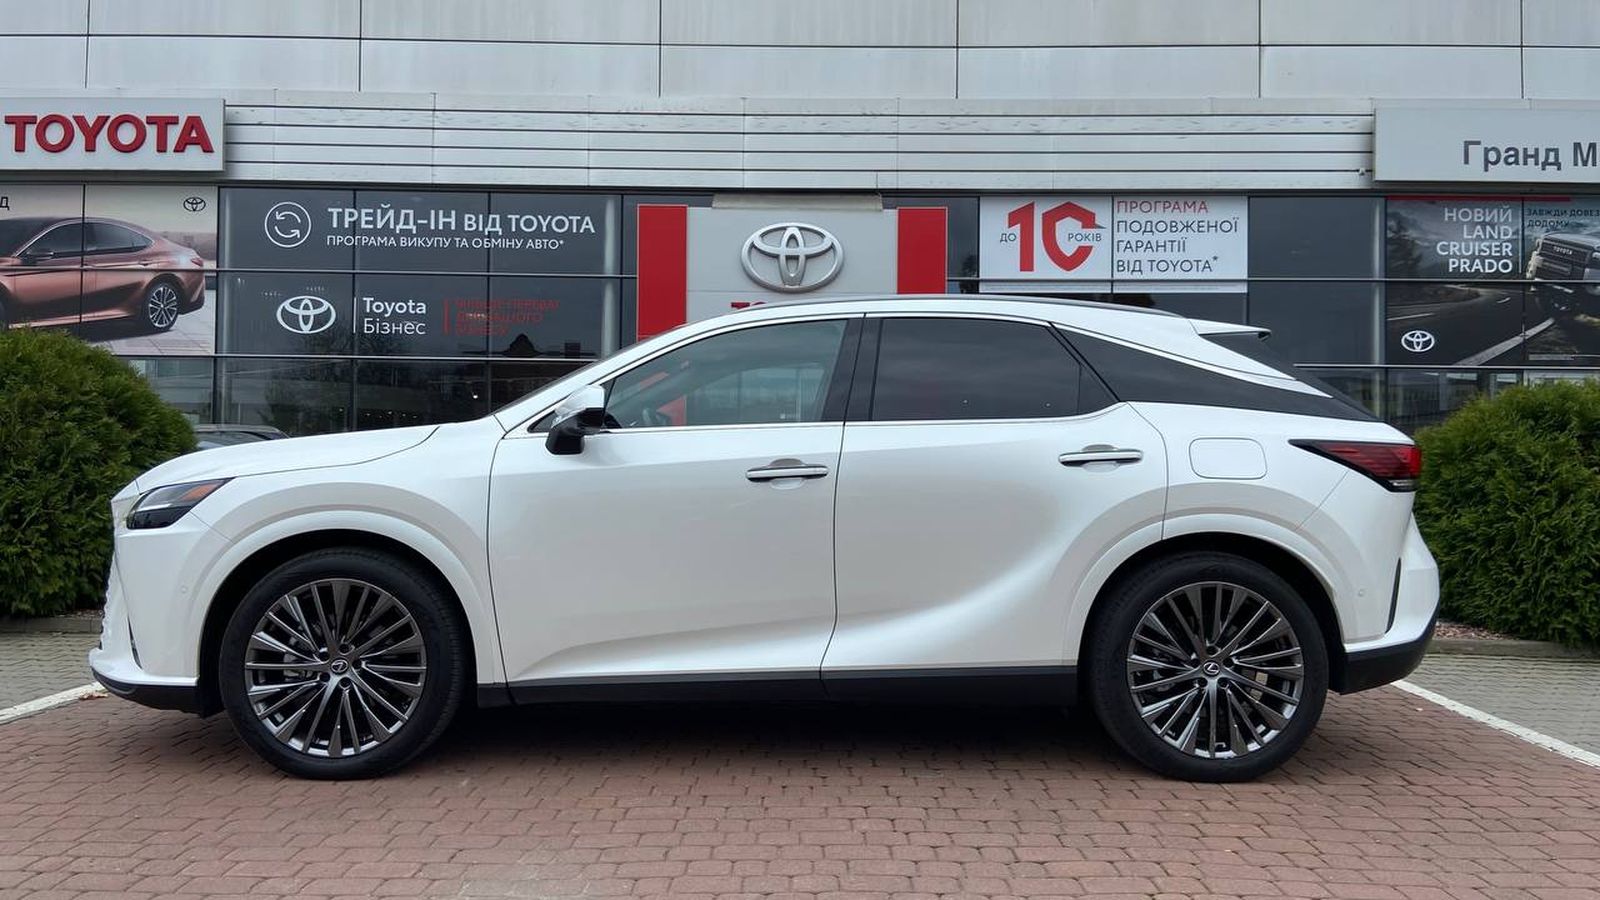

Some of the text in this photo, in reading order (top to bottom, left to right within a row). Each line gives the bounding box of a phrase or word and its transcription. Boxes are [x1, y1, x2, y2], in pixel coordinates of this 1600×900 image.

[4, 114, 215, 153] TOYOTA
[1463, 140, 1562, 172] Гранд
[1116, 200, 1209, 214] ПРОГРАМА
[1444, 205, 1513, 222] НОВИЙ
[327, 203, 596, 235] ТРЕЙД-ІН ВІД TOYOTA
[1116, 216, 1240, 236] ПОДОВЖЕНОЇ
[1527, 219, 1570, 228] ДОДОМУ
[999, 232, 1017, 243] ДО
[1067, 232, 1102, 242] РОКІВ
[1463, 225, 1513, 239] LAND
[326, 235, 397, 246] ПРОГРАМА
[400, 236, 452, 248] ВИКУПУ
[453, 237, 469, 248] ТА
[471, 238, 523, 249] ОБМІНУ
[1116, 236, 1188, 253] ГАРАНТІЇ
[1436, 241, 1513, 256] CRUISER
[1116, 259, 1143, 275] ВІД
[1448, 258, 1513, 273] PRADO
[362, 297, 427, 317] Toyota
[363, 318, 427, 335] Бізнес
